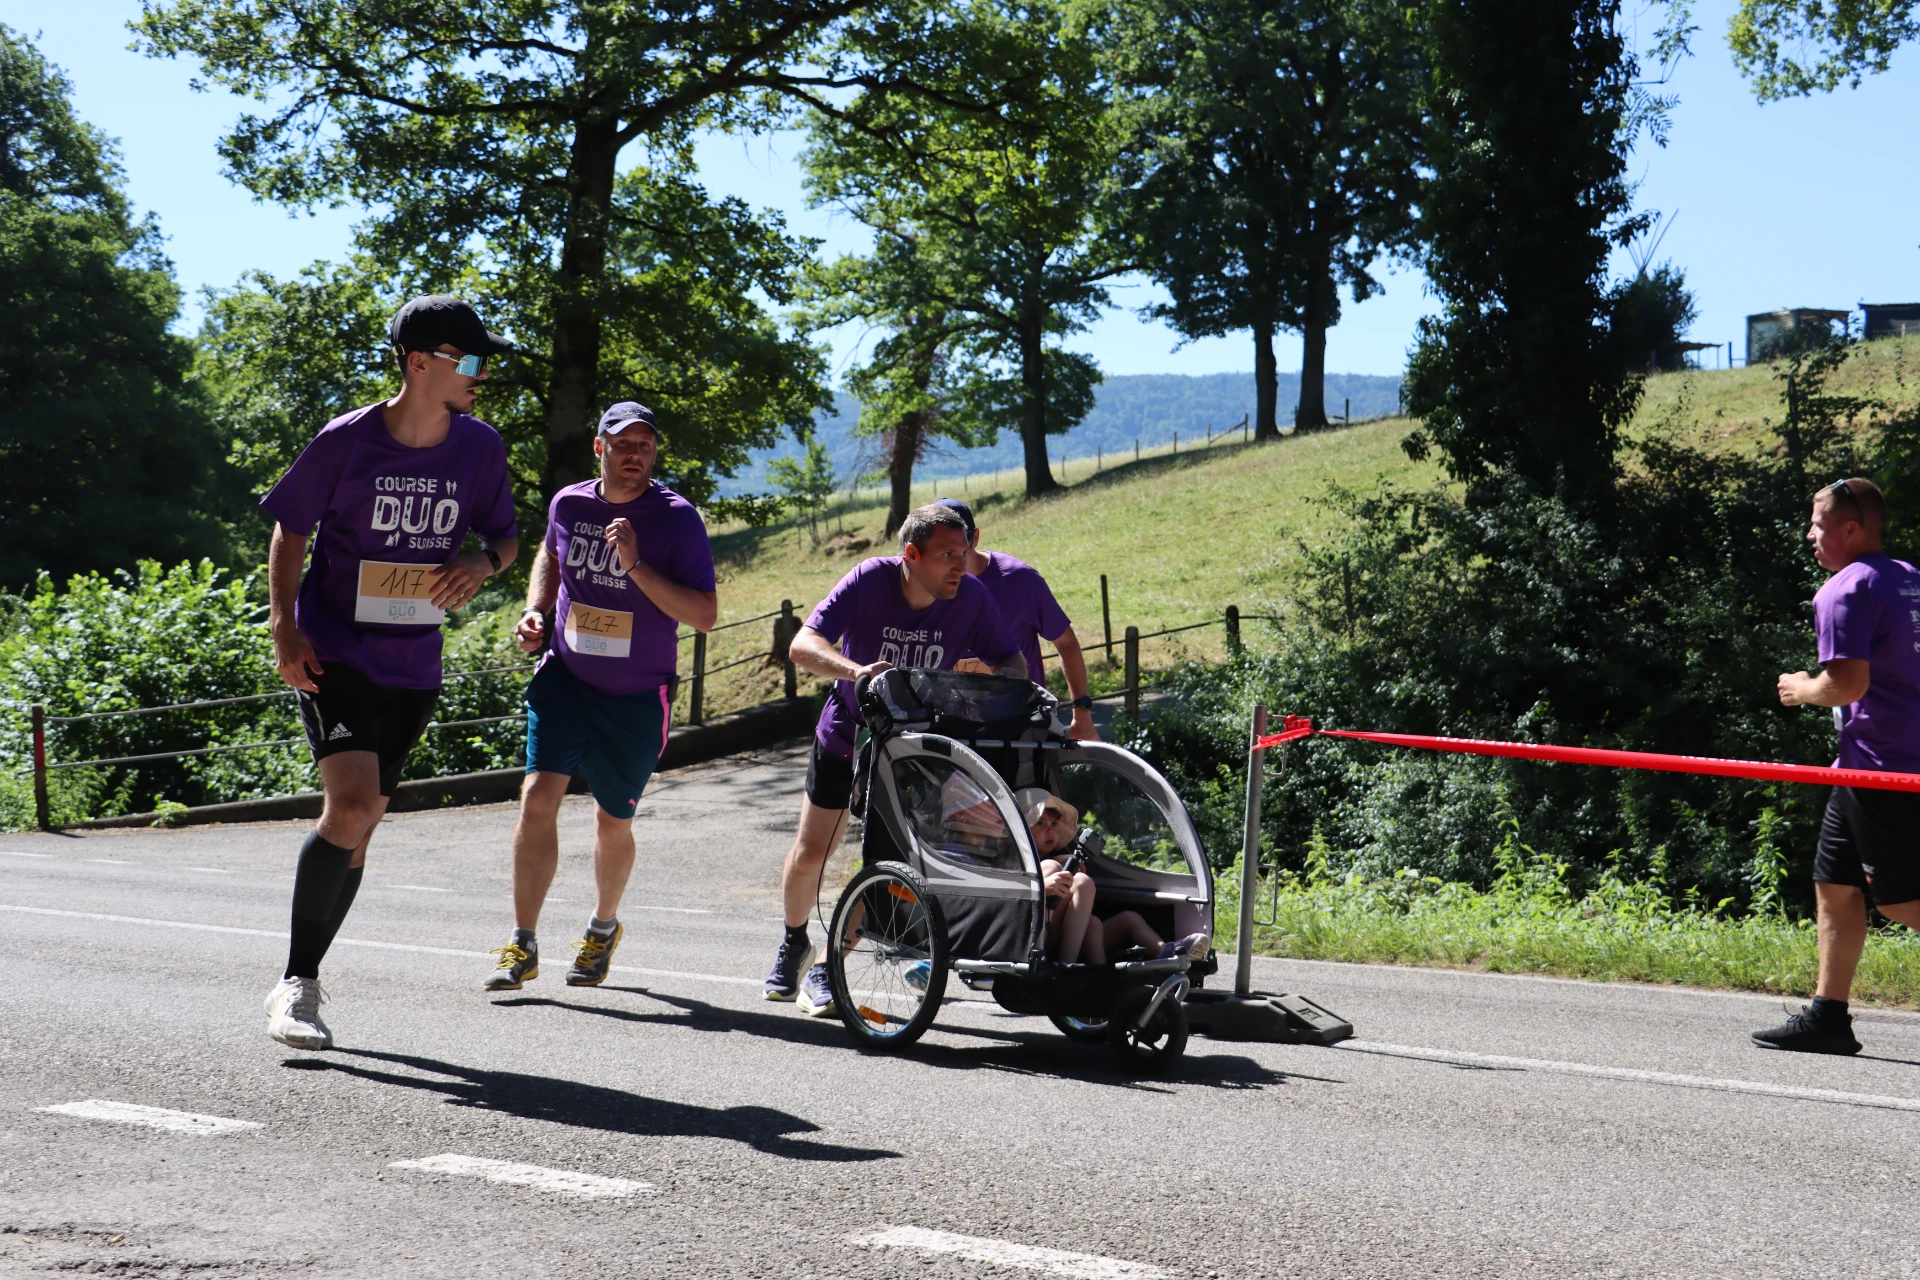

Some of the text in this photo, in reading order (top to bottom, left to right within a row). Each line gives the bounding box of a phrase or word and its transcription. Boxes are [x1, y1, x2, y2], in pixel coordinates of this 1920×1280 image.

[375, 476, 438, 494] COURSE
[371, 495, 460, 535] DUO
[408, 536, 452, 550] SUISSE
[380, 567, 426, 596] 117
[591, 573, 627, 590] SUISSE
[388, 605, 416, 617] DUO
[577, 611, 619, 633] 117
[882, 626, 928, 642] COURSE
[878, 641, 945, 670] DUO
